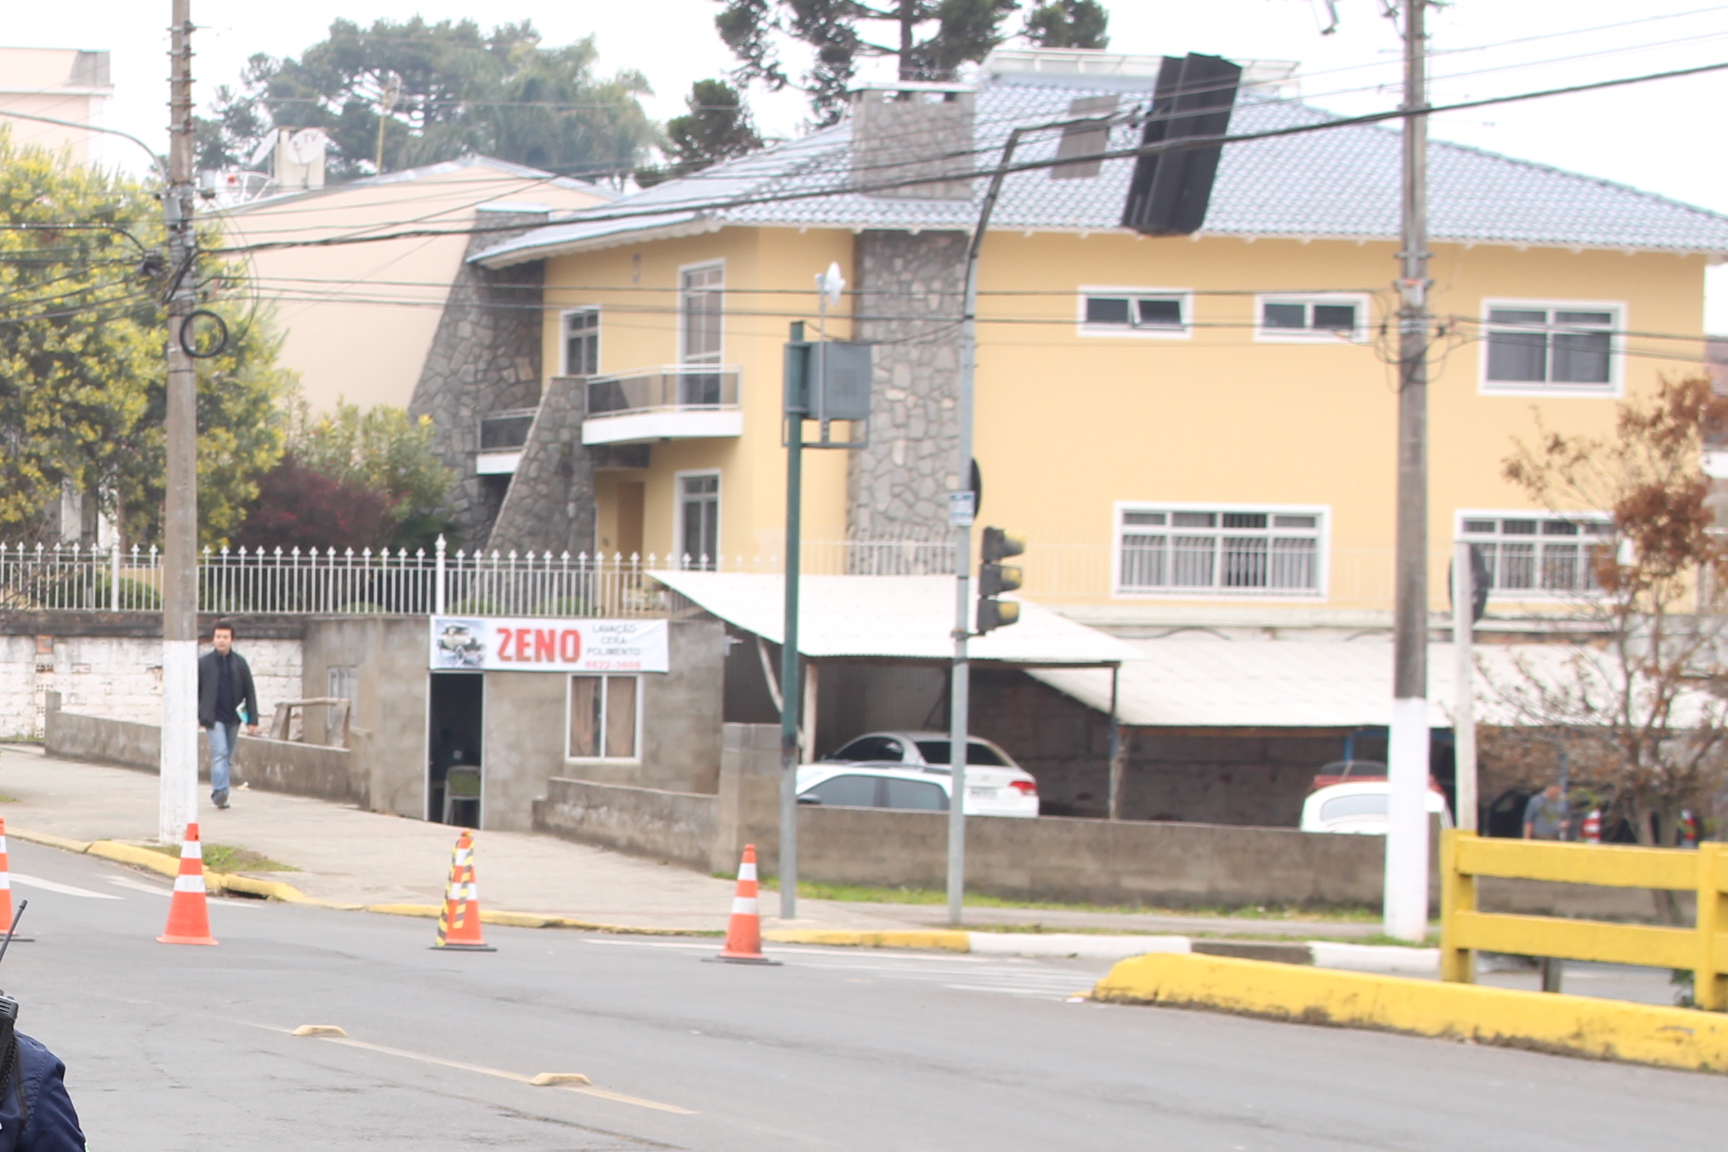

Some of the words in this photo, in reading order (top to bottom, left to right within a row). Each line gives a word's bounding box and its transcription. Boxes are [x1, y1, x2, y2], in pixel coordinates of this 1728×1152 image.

[495, 627, 581, 663] ZENO
[600, 636, 627, 645] CERA
[586, 647, 640, 656] POLIMENTO
